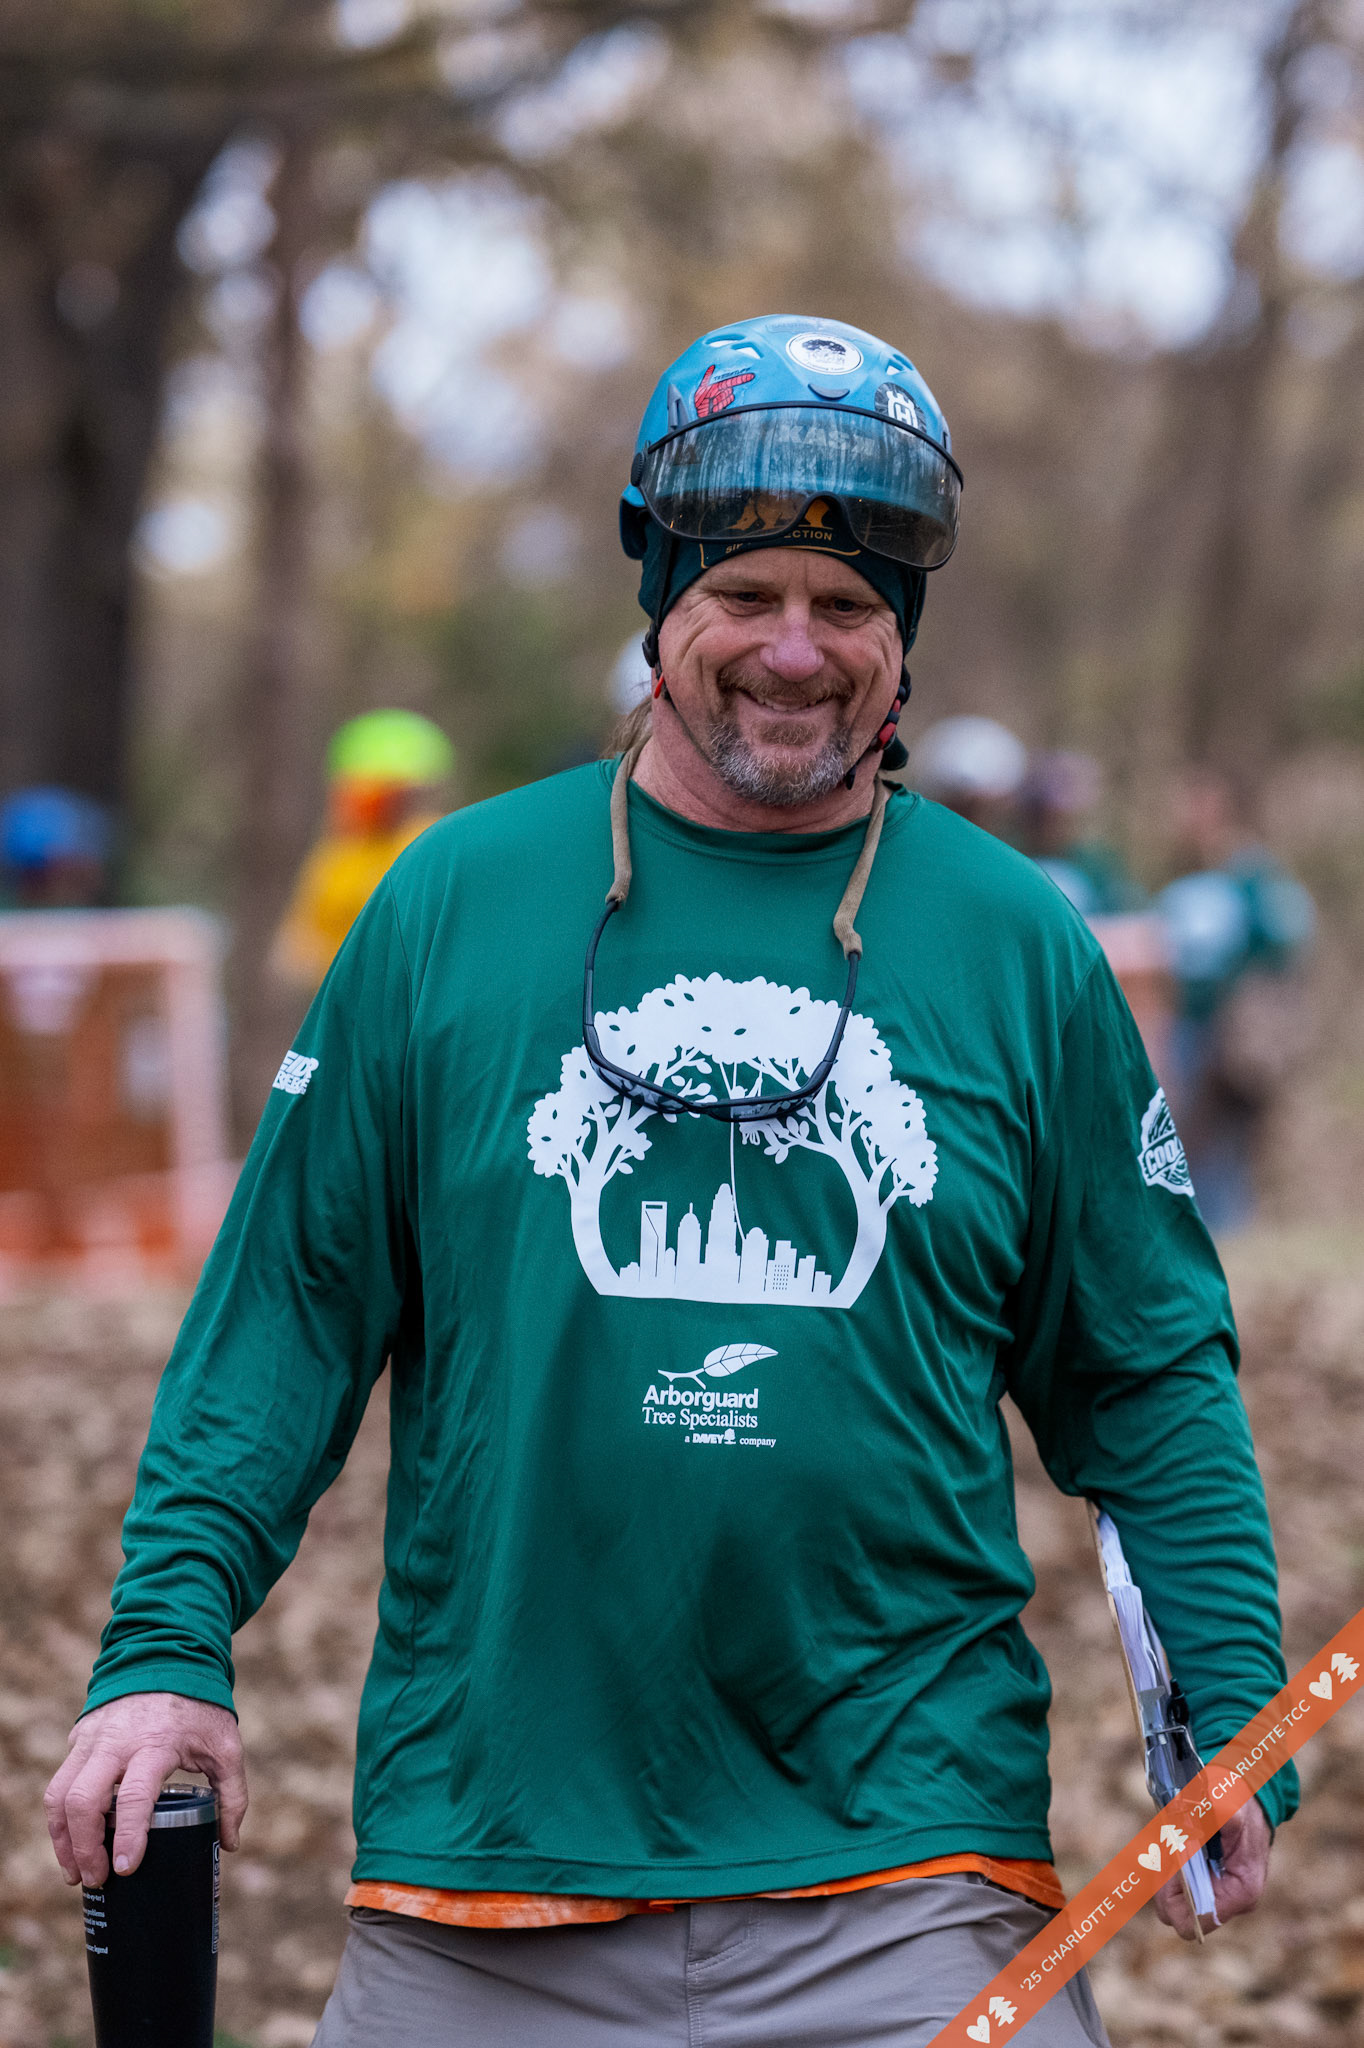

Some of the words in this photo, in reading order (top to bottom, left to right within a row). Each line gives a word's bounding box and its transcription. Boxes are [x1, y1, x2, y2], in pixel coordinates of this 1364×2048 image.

[642, 1384, 759, 1412] Arborguard
[642, 1406, 676, 1425] Tree
[679, 1408, 758, 1430] Specialists
[692, 1433, 725, 1444] DAVEY
[739, 1437, 777, 1447] company
